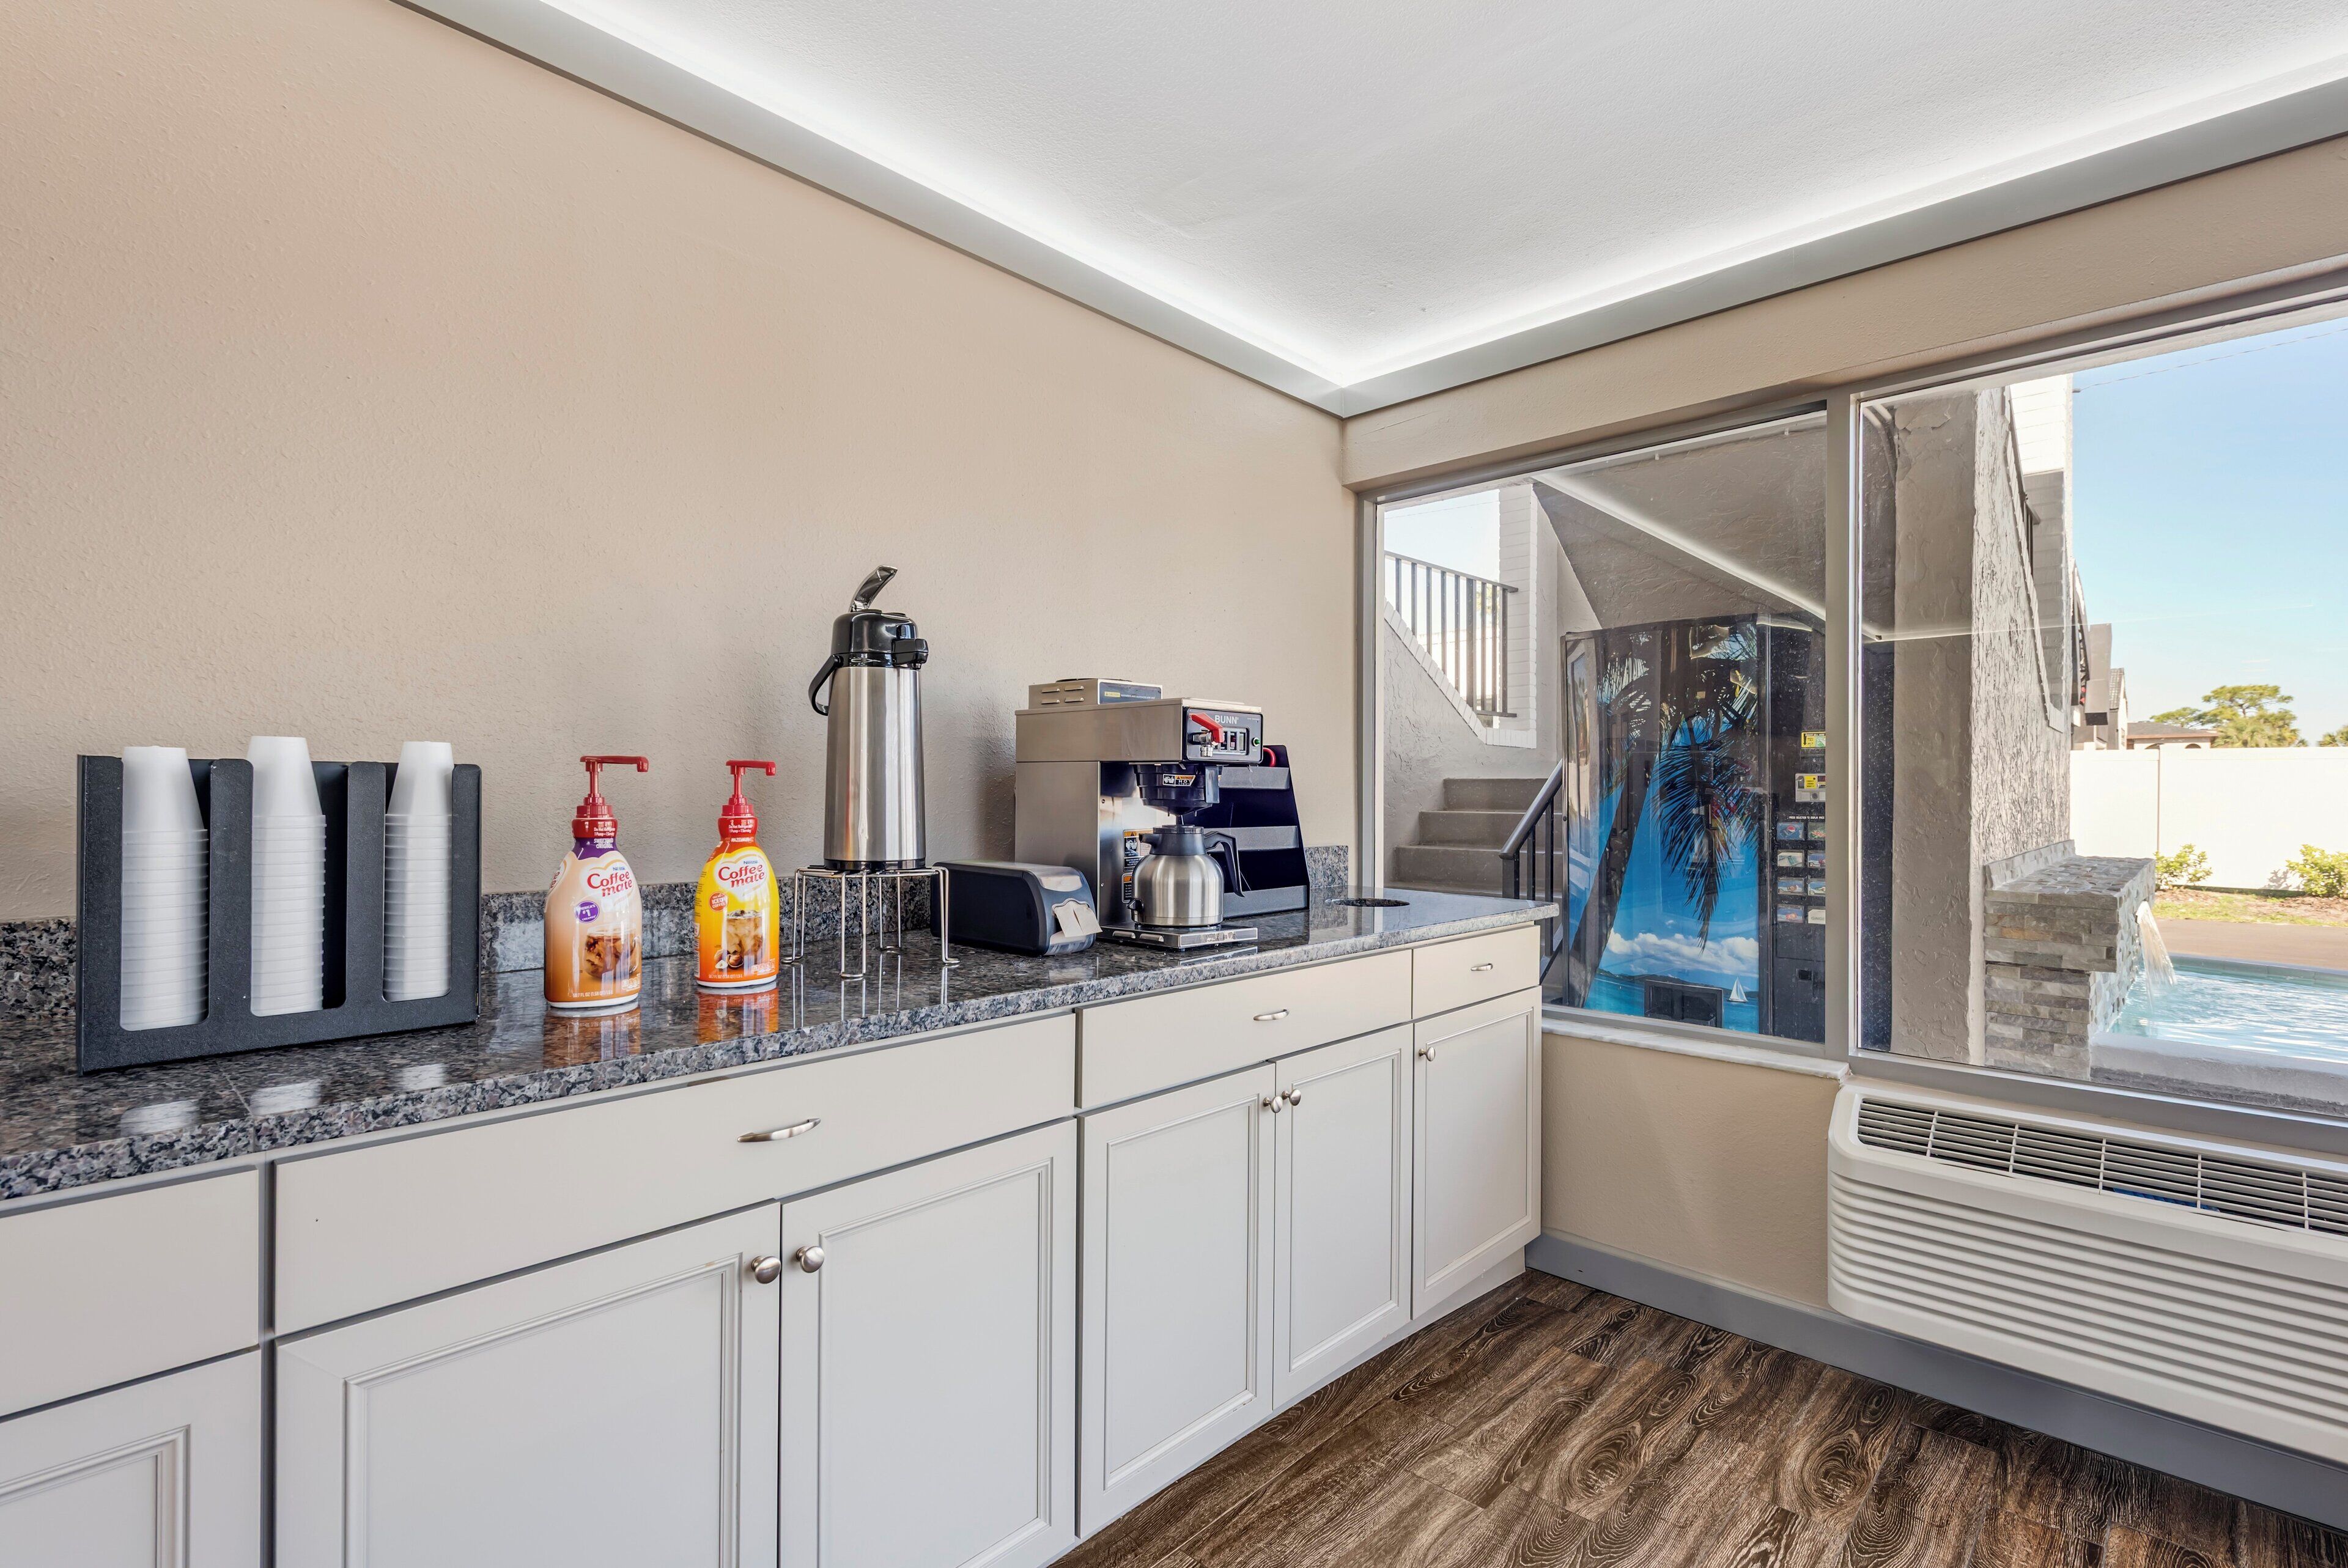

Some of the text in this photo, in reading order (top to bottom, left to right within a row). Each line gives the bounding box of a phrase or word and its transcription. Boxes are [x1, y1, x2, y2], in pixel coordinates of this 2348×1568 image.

[587, 871, 630, 889] Coffee
[718, 864, 762, 881] Coffee
[731, 872, 764, 888] mate
[602, 879, 632, 897] mate
